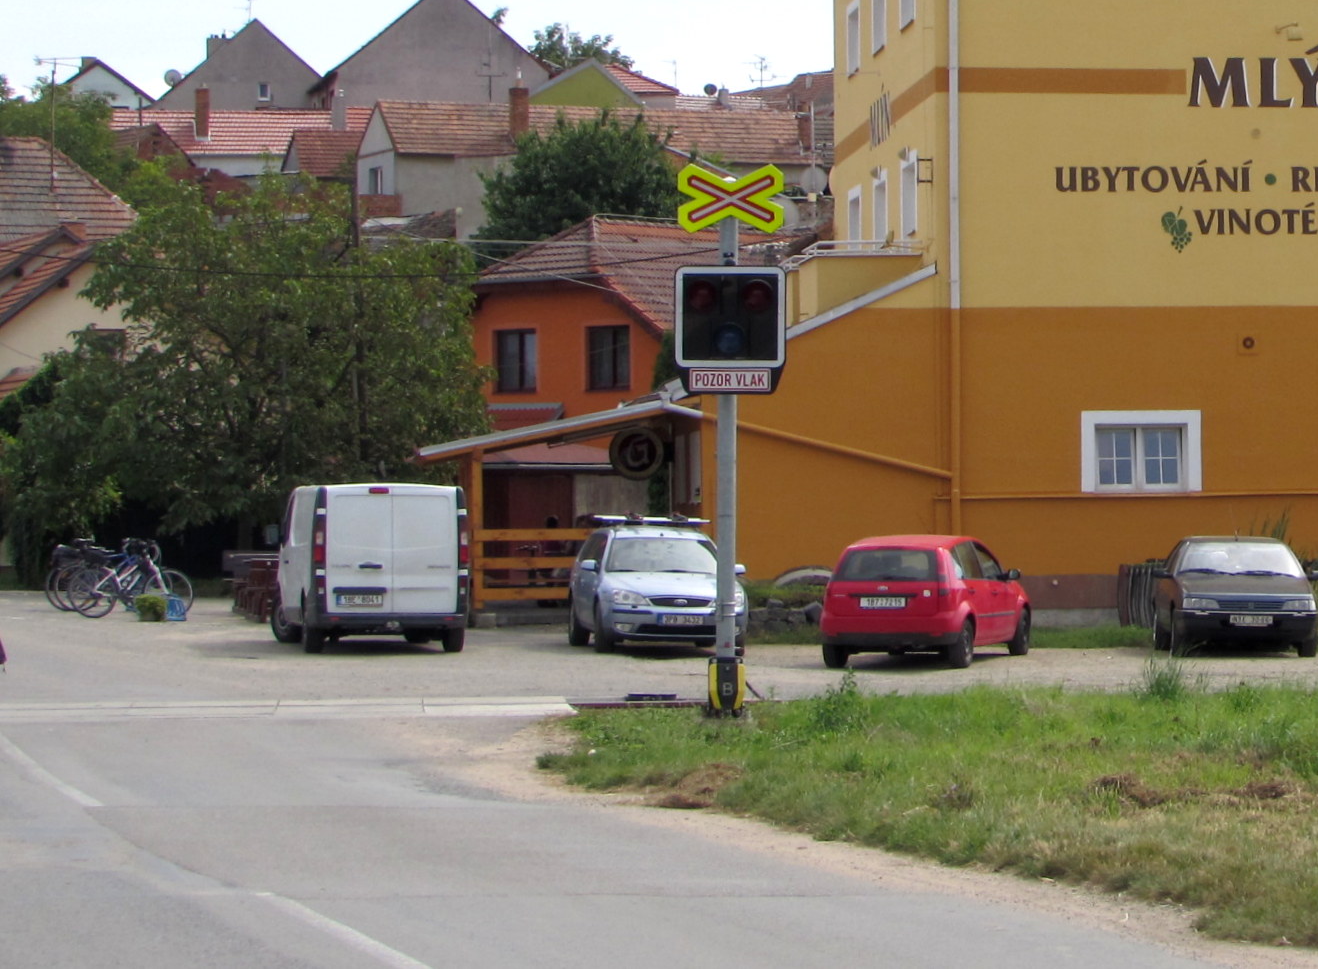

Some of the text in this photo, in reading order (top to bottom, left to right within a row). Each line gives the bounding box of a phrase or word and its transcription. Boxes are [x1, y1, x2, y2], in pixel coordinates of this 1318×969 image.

[1054, 159, 1253, 193] UBYTOVÁNÍ
[694, 373, 765, 387] POZOR VLAK
